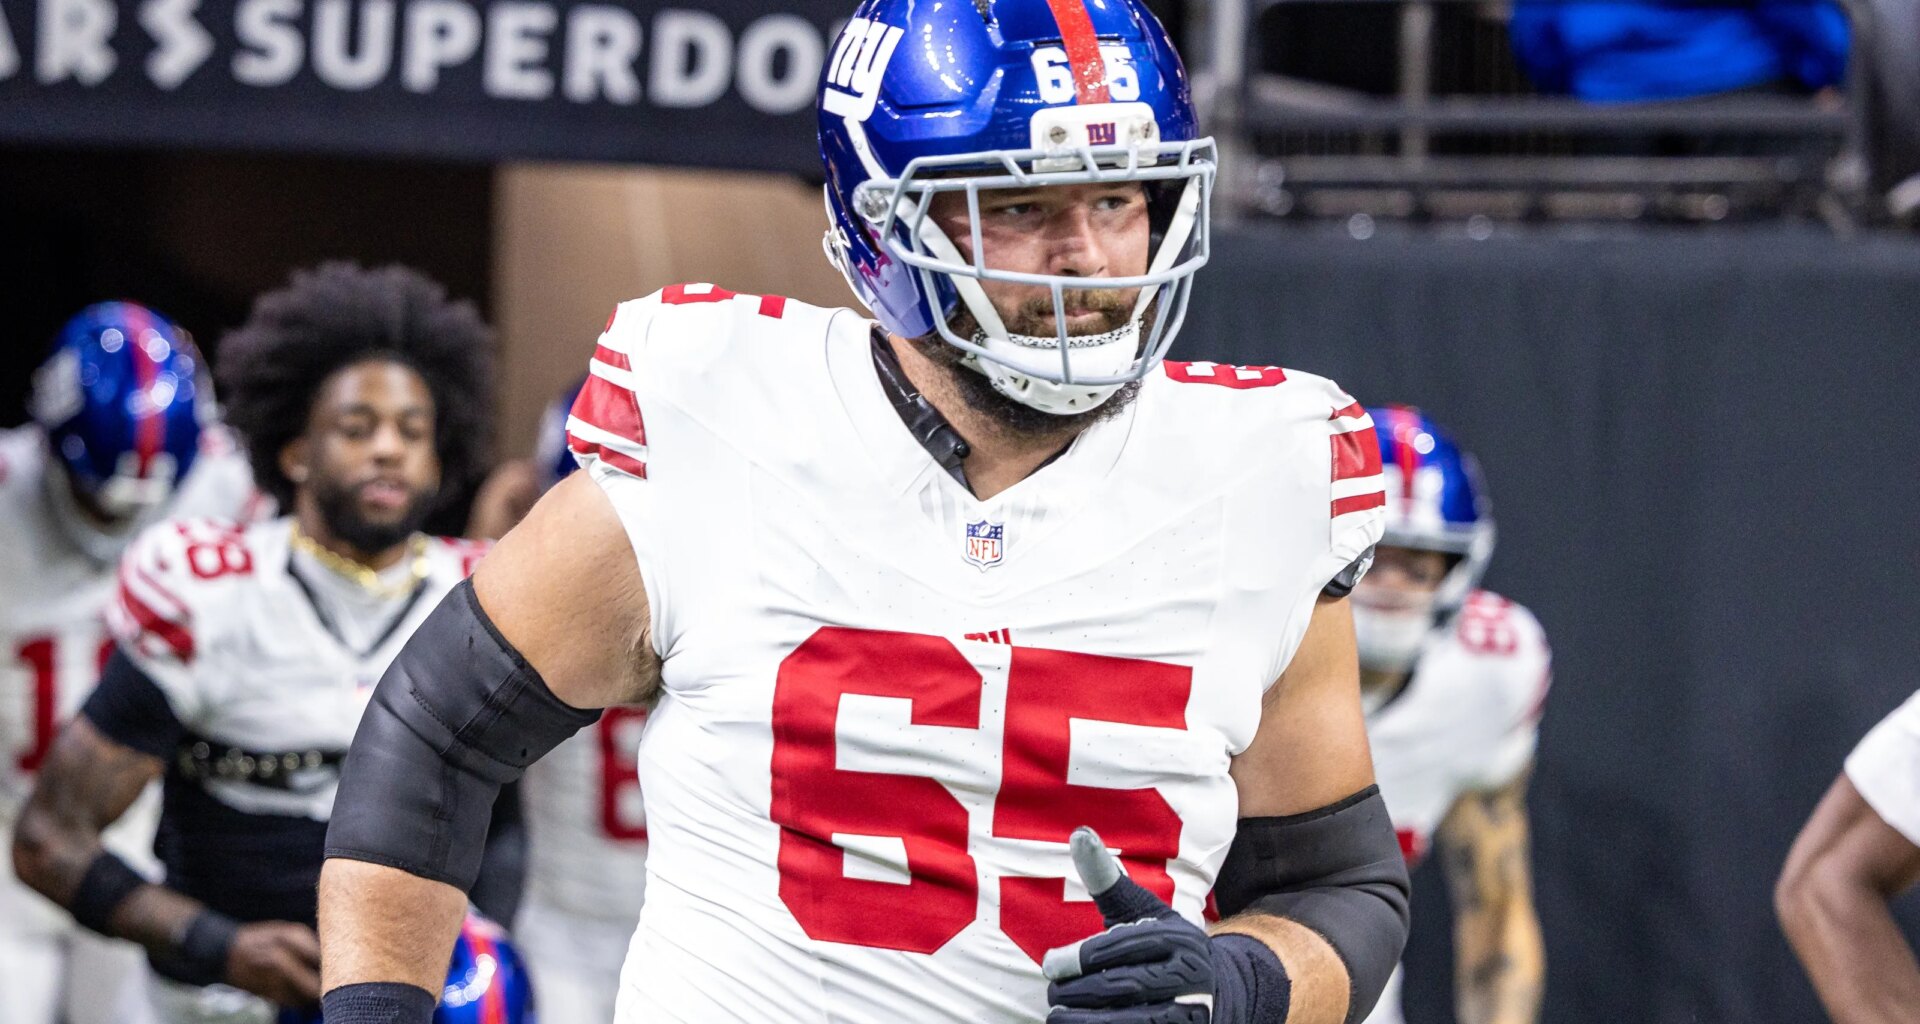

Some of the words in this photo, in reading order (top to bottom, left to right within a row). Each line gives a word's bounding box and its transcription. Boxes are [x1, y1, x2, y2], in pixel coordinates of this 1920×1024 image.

[230, 0, 848, 115] SUPERDO
[1030, 46, 1140, 104] 65
[969, 538, 999, 560] NFL
[770, 625, 1194, 969] 65
